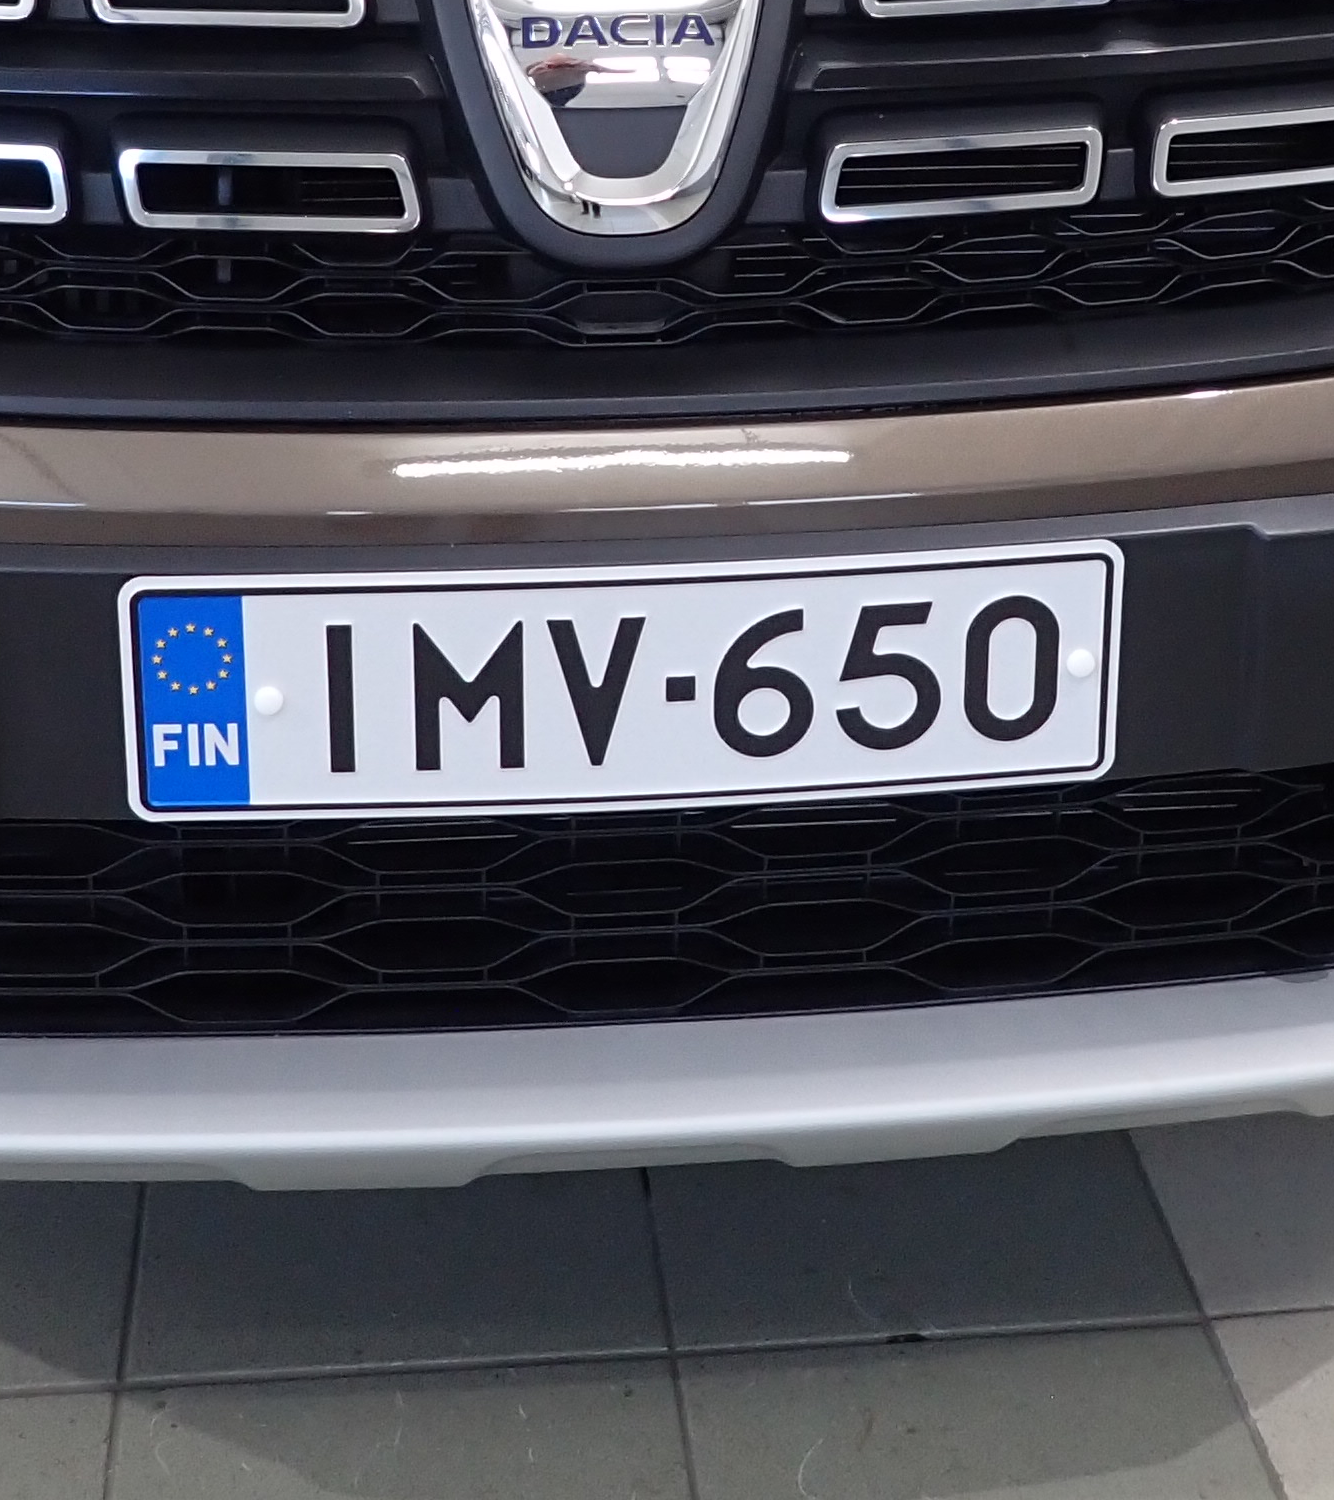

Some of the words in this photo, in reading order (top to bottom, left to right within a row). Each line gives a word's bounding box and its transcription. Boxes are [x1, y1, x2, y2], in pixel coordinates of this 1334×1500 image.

[521, 13, 716, 49] DACIA
[324, 594, 1061, 773] IMV-650
[152, 721, 242, 768] FIN
